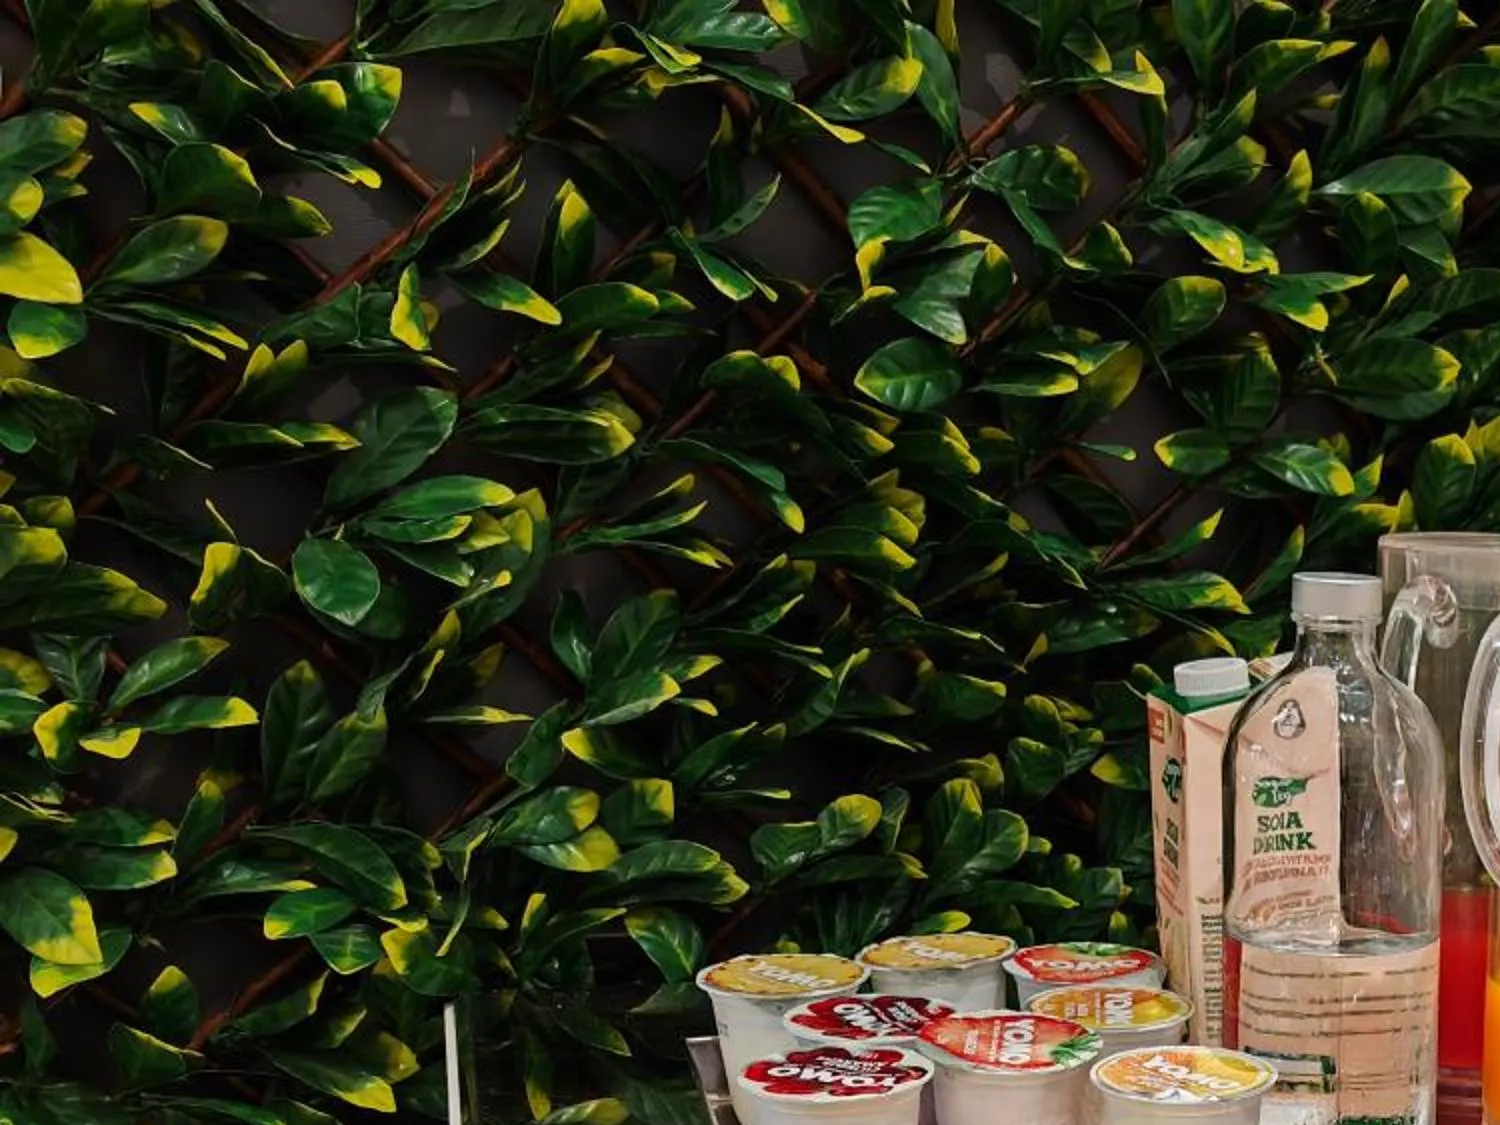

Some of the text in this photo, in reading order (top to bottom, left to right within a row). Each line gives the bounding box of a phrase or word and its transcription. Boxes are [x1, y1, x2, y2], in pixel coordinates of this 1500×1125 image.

[1253, 831, 1316, 855] DRINK
[748, 960, 836, 987] YOMO
[1022, 957, 1141, 971] YOMO
[999, 1019, 1034, 1064] YOMO
[767, 1066, 896, 1087] YOMO
[1143, 1056, 1240, 1089] YOMO
